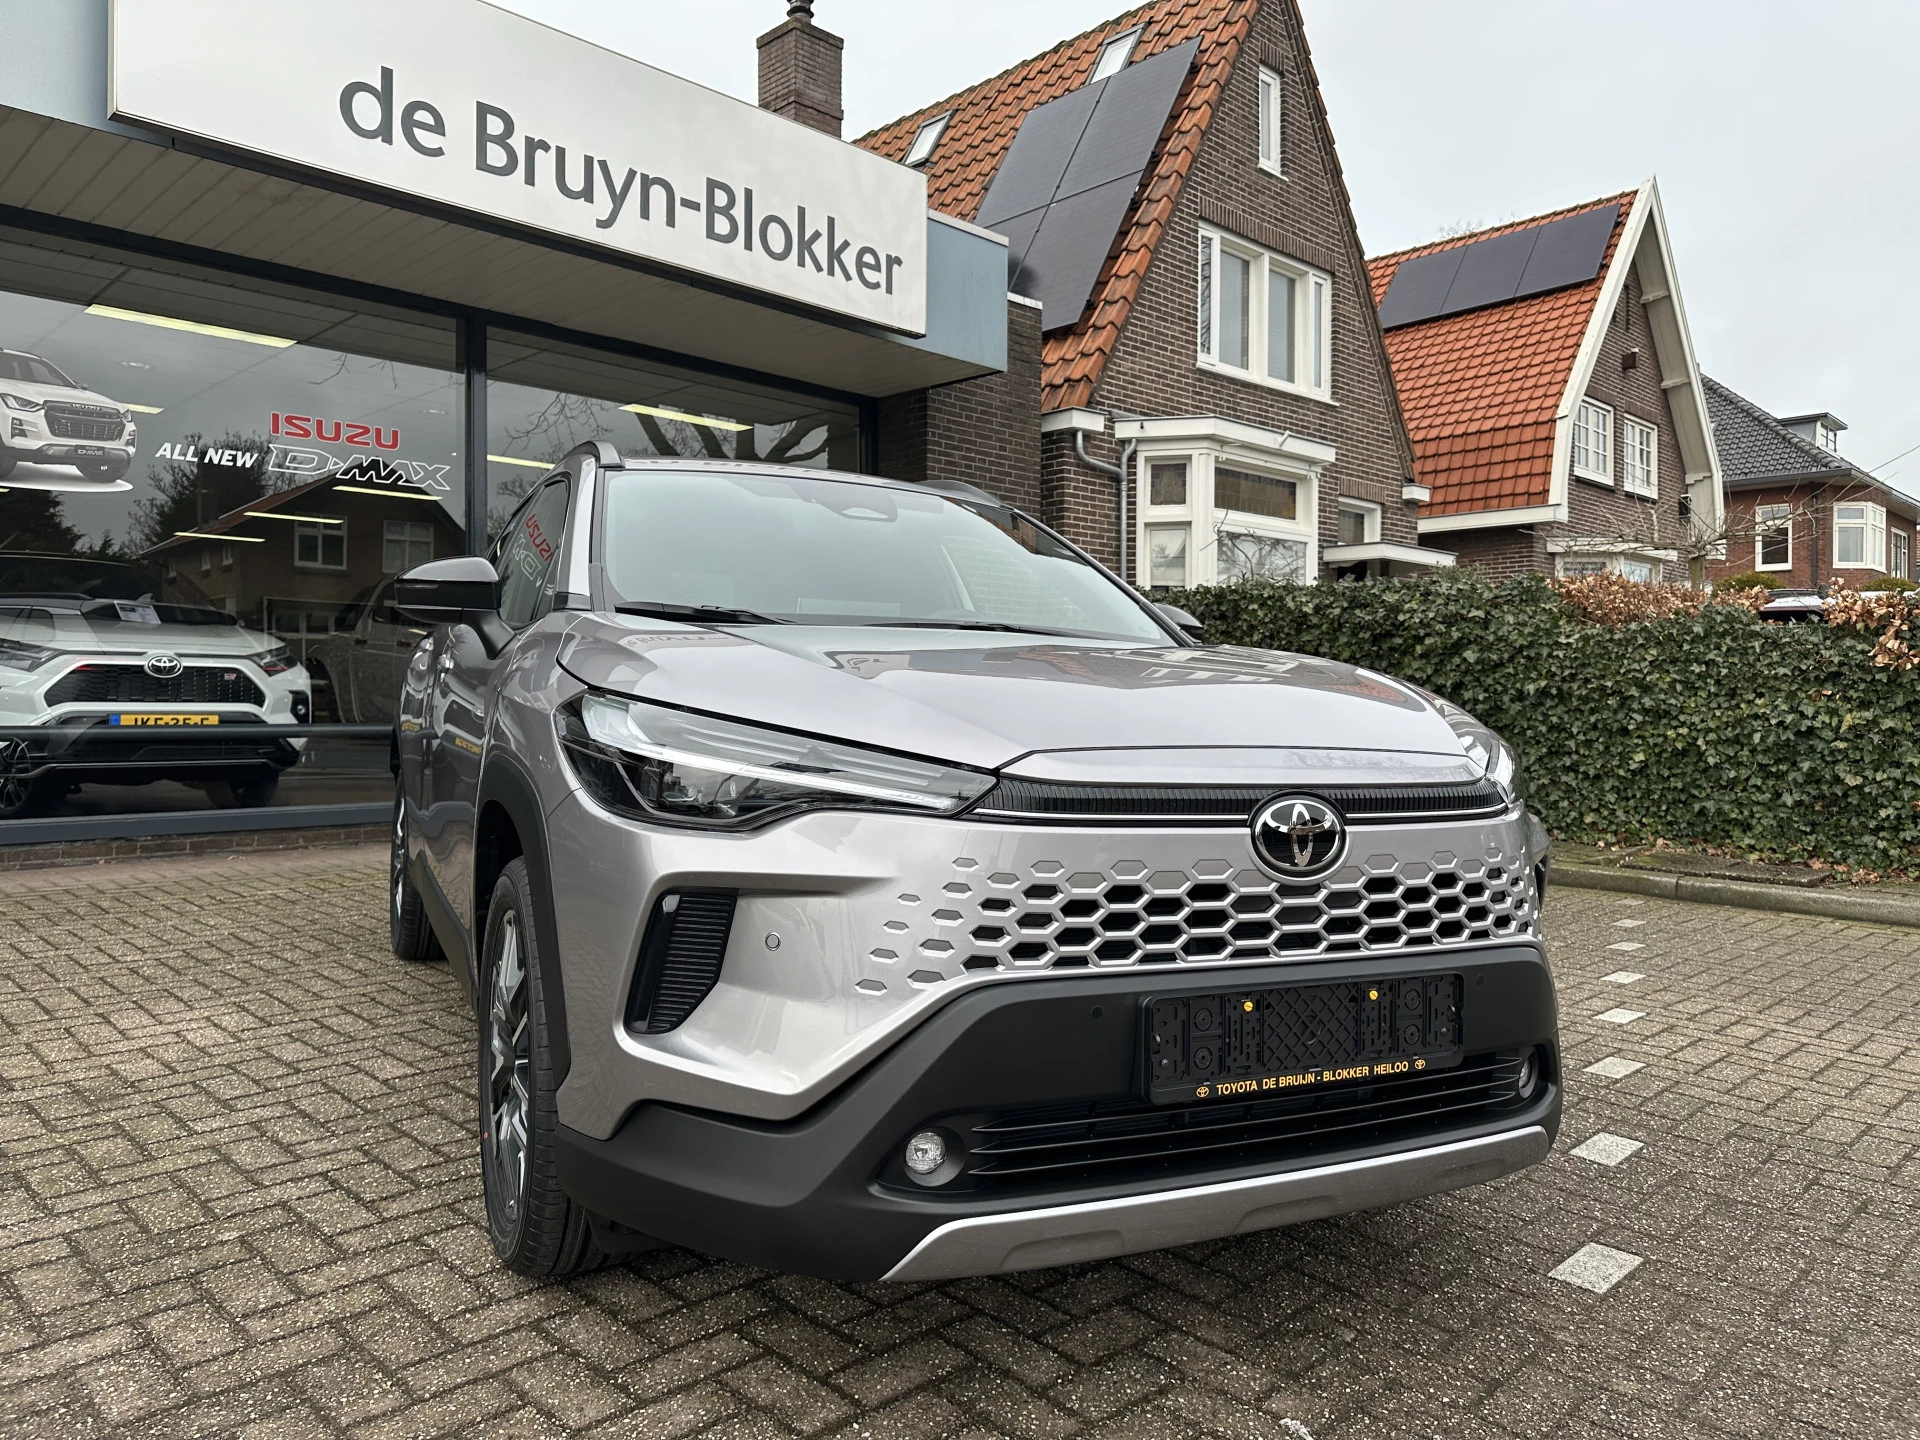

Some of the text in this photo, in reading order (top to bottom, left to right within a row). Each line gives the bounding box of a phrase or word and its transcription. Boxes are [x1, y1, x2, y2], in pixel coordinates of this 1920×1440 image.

[339, 65, 903, 295] de Bruyn-Blokker
[270, 411, 400, 451] ISUZU
[155, 442, 451, 491] ALL NEW D-MAX
[1216, 1080, 1258, 1096] TOYOTA
[1262, 1077, 1277, 1090] DE
[1279, 1073, 1316, 1088] BRUIJN
[1323, 1066, 1370, 1082] BLOKKER
[1373, 1061, 1409, 1075] HEILOO
